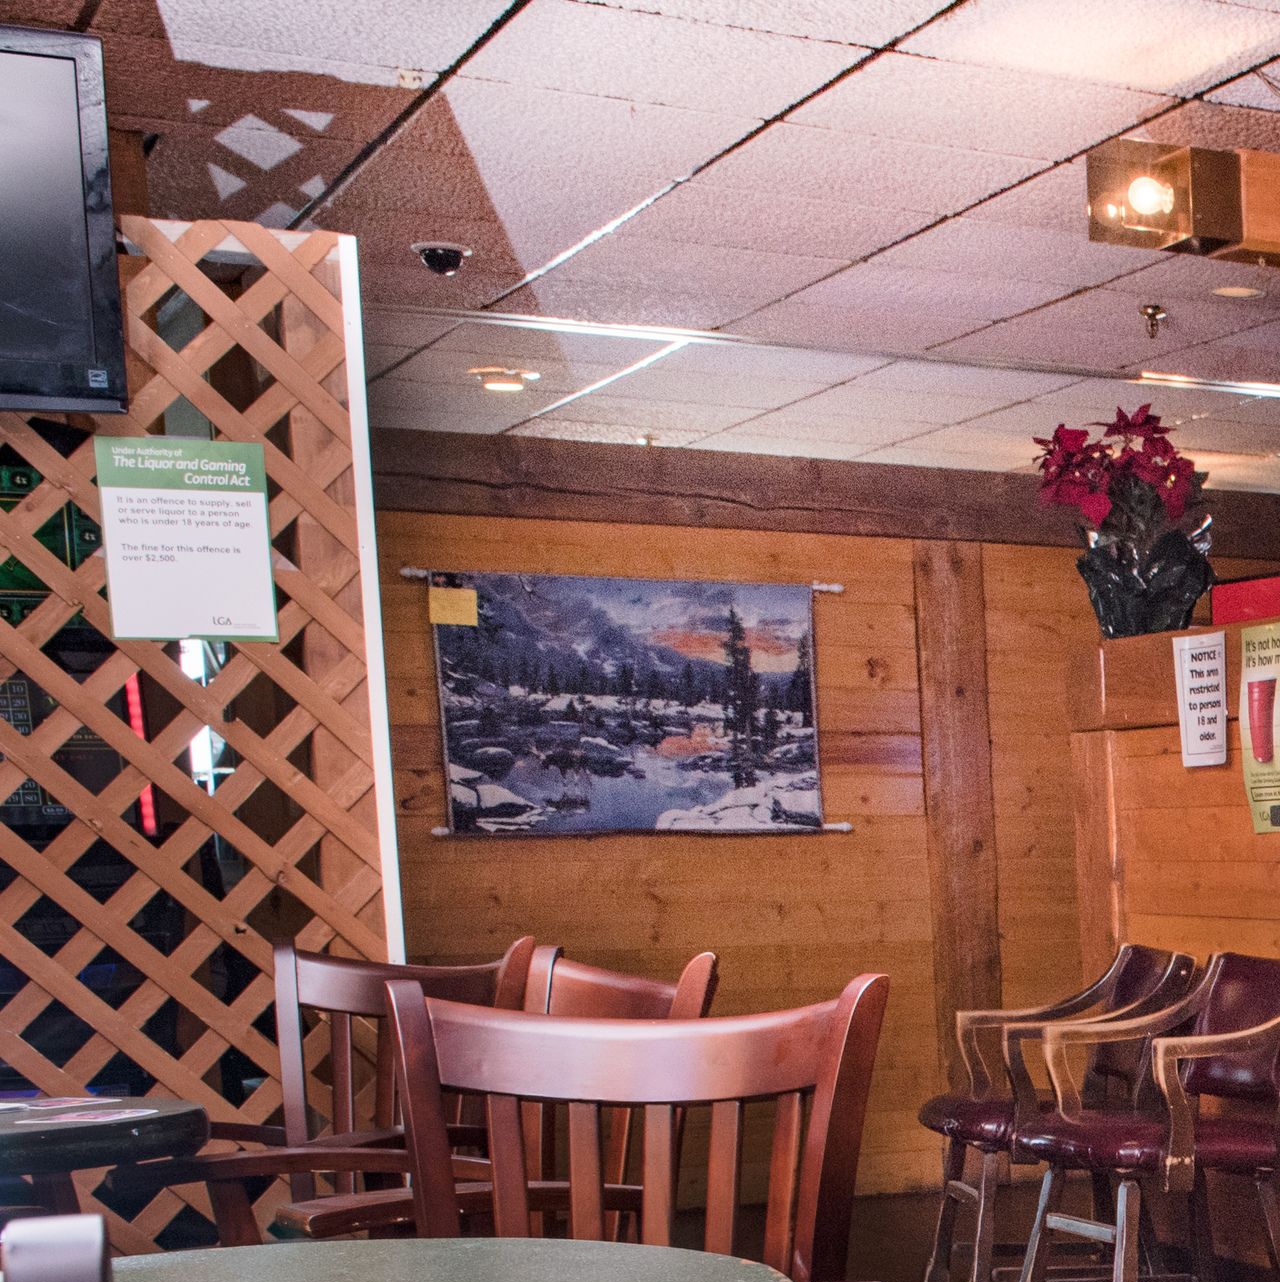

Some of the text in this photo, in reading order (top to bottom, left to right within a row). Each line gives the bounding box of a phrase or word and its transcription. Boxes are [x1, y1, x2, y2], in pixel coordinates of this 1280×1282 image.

[112, 446, 183, 458] Under Authority of
[113, 456, 246, 475] The Liquor and Gaming
[184, 473, 251, 486] Control Act
[126, 496, 133, 504] is
[151, 497, 185, 505] offence
[158, 508, 185, 518] liquor
[208, 511, 240, 519] person
[119, 517, 139, 525] who
[152, 518, 178, 526] under
[182, 518, 192, 526] 18
[195, 520, 219, 528] years
[121, 543, 139, 551] The
[141, 544, 158, 552] fine
[161, 544, 174, 552] for
[177, 545, 194, 553] this
[197, 545, 230, 554] offence
[122, 554, 143, 562] over
[212, 616, 232, 626] LGA
[1245, 639, 1256, 653] It's
[1258, 638, 1270, 651] not
[1191, 650, 1216, 662] NOTICE
[1258, 653, 1274, 666] how
[1190, 668, 1219, 680] This area
[1189, 684, 1220, 696] restricted
[1188, 699, 1222, 712] to persons
[1197, 714, 1218, 726] 18 and
[1199, 731, 1216, 741] older.
